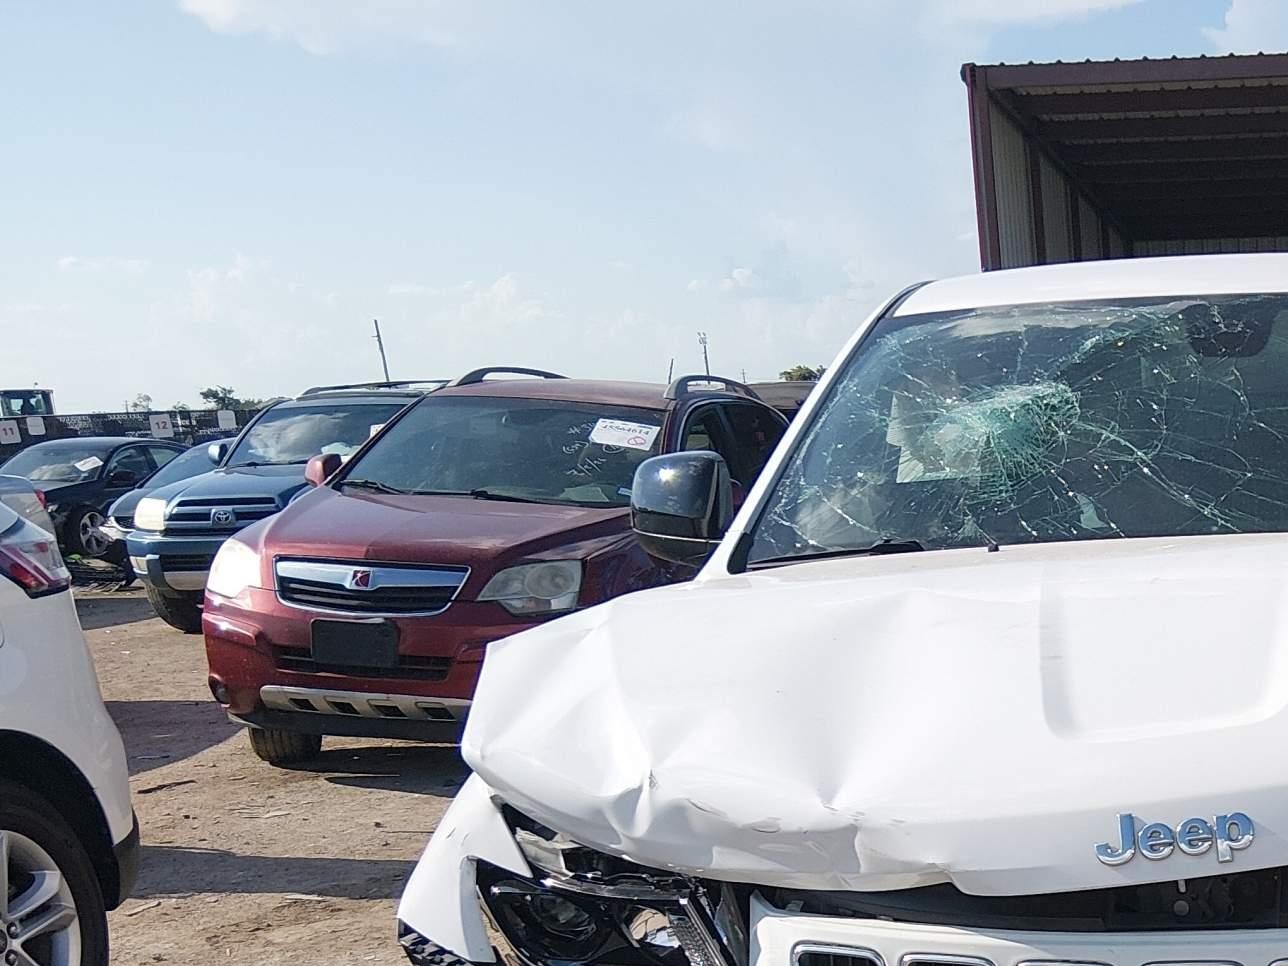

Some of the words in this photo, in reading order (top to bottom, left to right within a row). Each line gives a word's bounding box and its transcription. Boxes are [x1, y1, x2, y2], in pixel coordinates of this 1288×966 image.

[154, 421, 169, 431] 12
[2, 427, 15, 436] 11
[1094, 812, 1255, 867] Jeep
